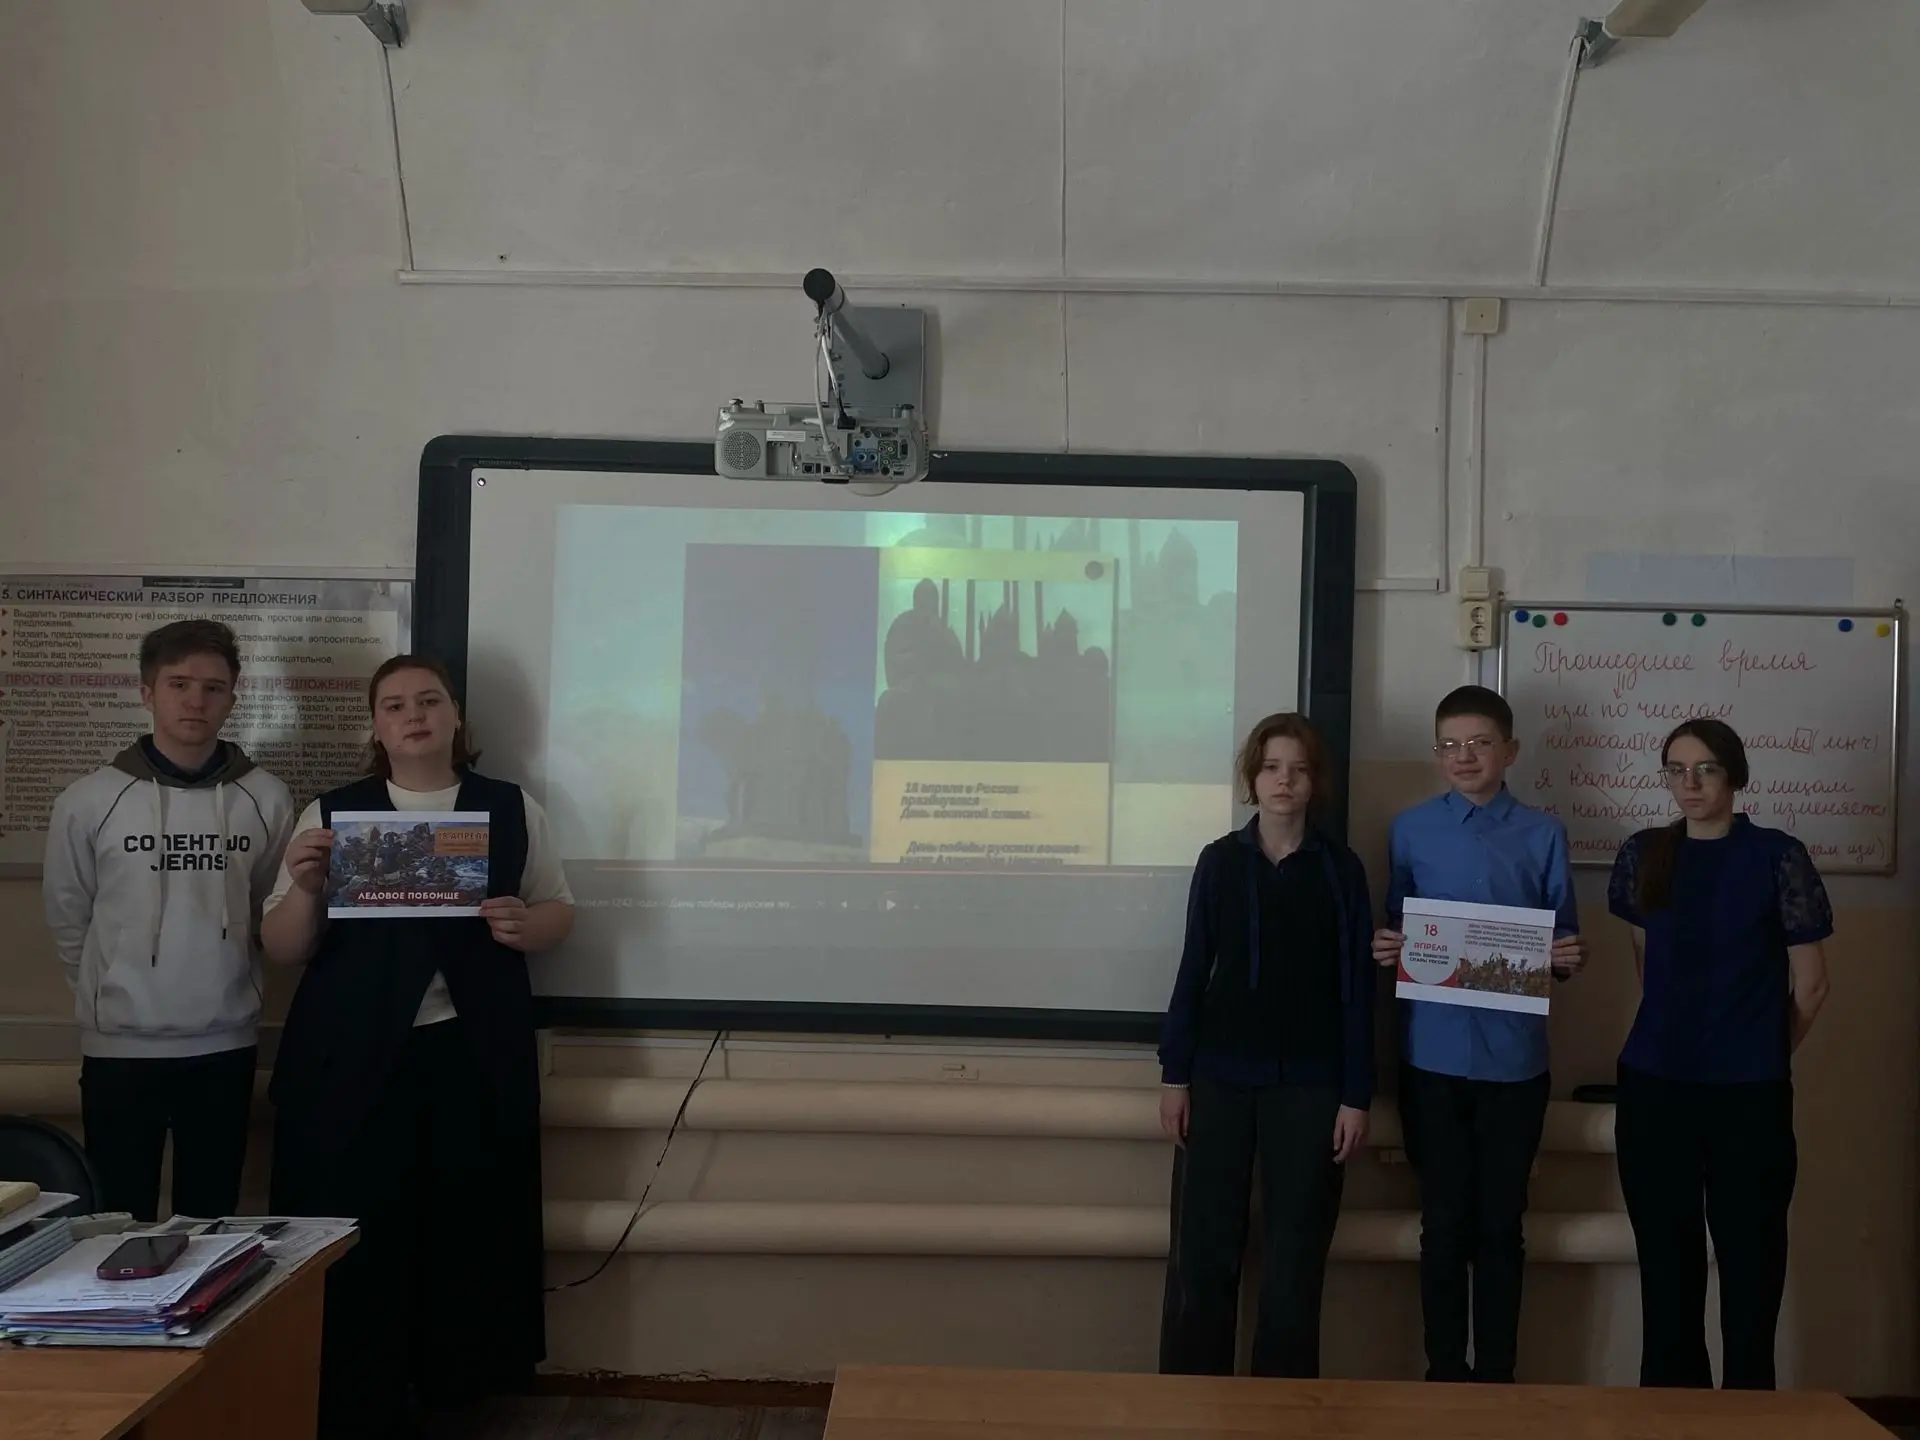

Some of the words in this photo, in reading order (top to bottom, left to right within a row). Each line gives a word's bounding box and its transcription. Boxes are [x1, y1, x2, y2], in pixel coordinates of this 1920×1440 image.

[17, 588, 144, 602] СИНТАКСИЧЕСКИЙ
[151, 592, 205, 603] РАЗБОР
[212, 593, 317, 606] ПРЕДЛОЖЕНИЯ
[1533, 641, 1696, 690] Прошедшее
[1718, 639, 1818, 688] время
[6, 674, 63, 685] ПРОСТОЕ
[70, 675, 140, 687] ПРЕДЛОЖЕ
[266, 679, 361, 691] ПРЕДЛОЖЕНИЕ
[1601, 703, 1628, 718] по
[1742, 800, 1760, 816] не
[150, 853, 228, 872] JEANS
[358, 891, 404, 900] ЛЕДОВОЕ
[407, 892, 459, 901] ПОБОИЩЕ
[1424, 923, 1439, 937] 18
[1413, 942, 1448, 953] АПРЕЛЯ
